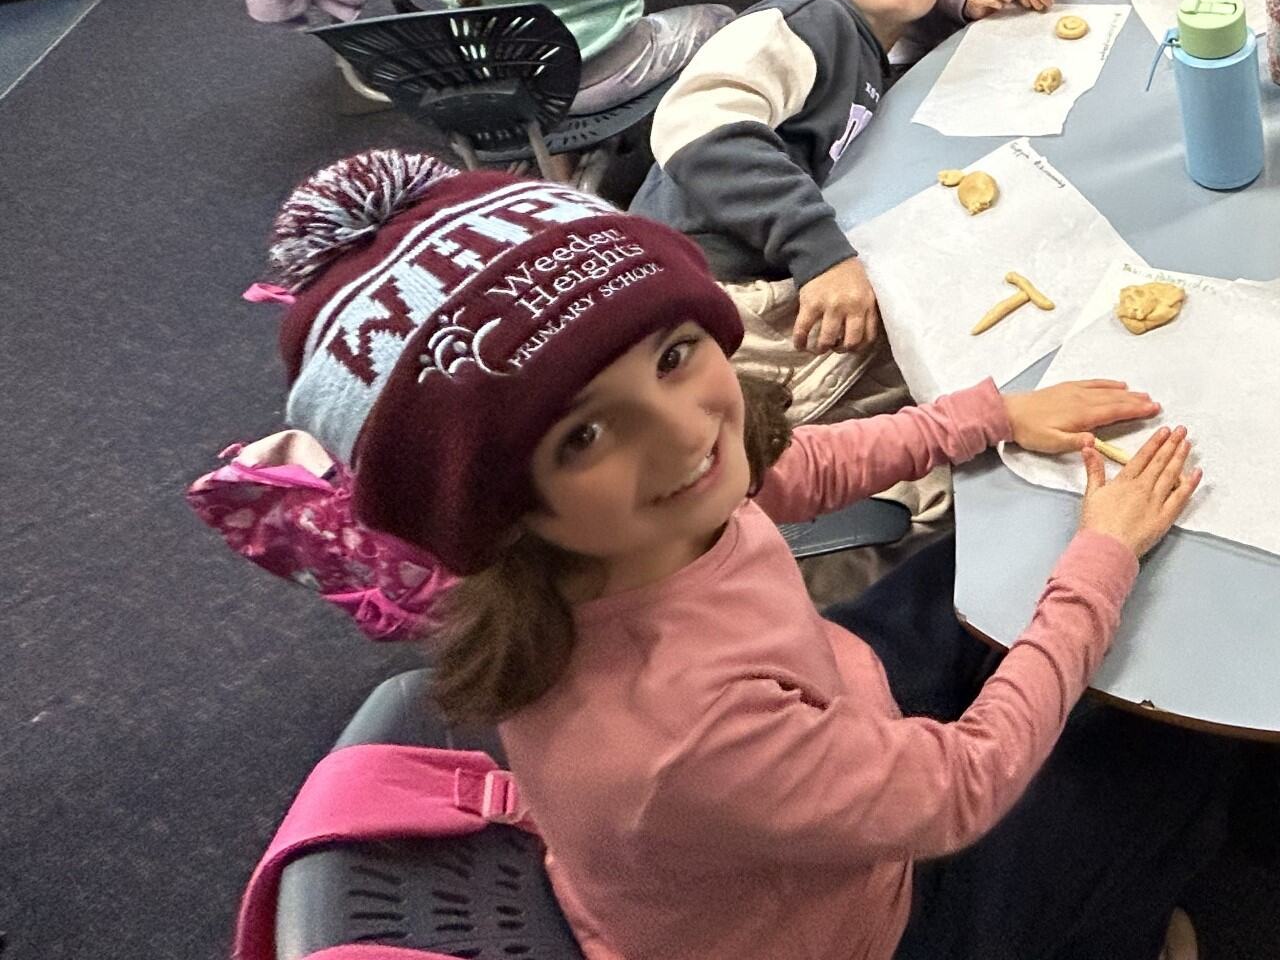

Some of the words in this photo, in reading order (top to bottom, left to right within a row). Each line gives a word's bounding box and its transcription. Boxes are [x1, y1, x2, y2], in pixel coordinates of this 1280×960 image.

[484, 228, 626, 298] Weeden
[514, 243, 644, 319] Heights
[507, 293, 596, 368] PRIMARY
[598, 262, 664, 298] SCHOOL
